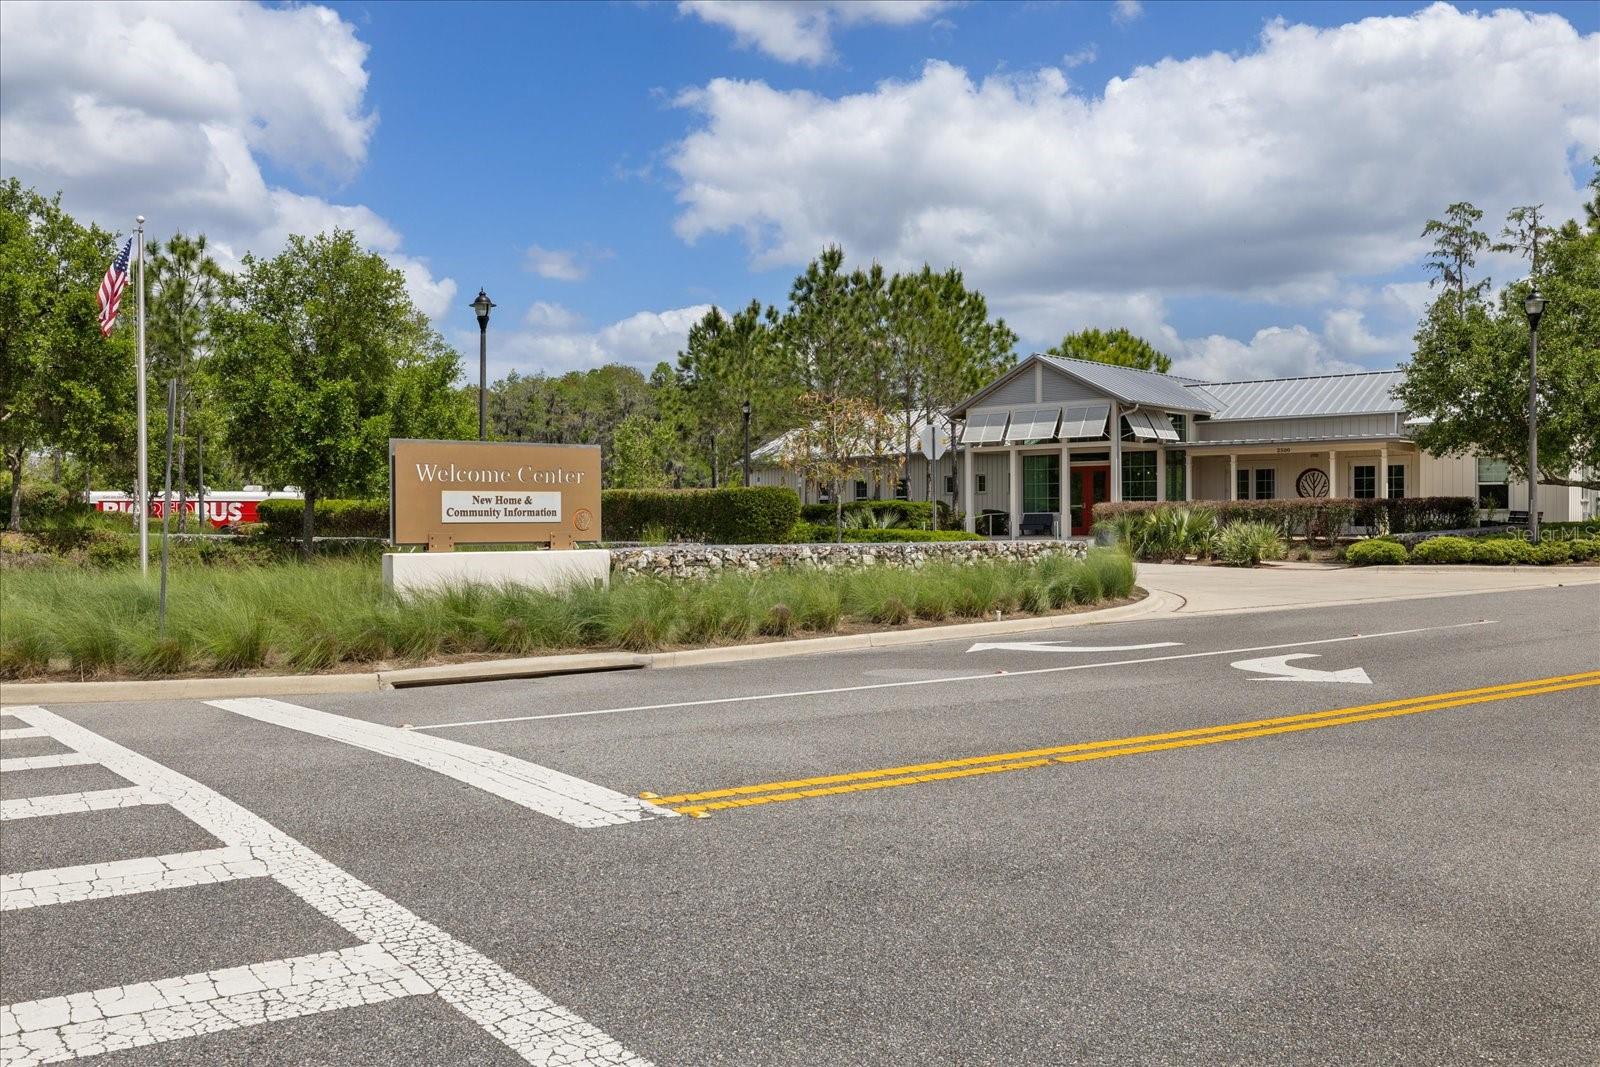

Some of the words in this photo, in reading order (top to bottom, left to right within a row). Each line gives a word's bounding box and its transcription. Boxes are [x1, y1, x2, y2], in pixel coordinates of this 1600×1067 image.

[415, 463, 511, 483] Welcome
[517, 464, 585, 485] Center
[472, 495, 493, 505] New
[495, 495, 522, 505] Home
[524, 495, 533, 505] &
[446, 507, 501, 519] Community
[503, 507, 557, 518] Information
